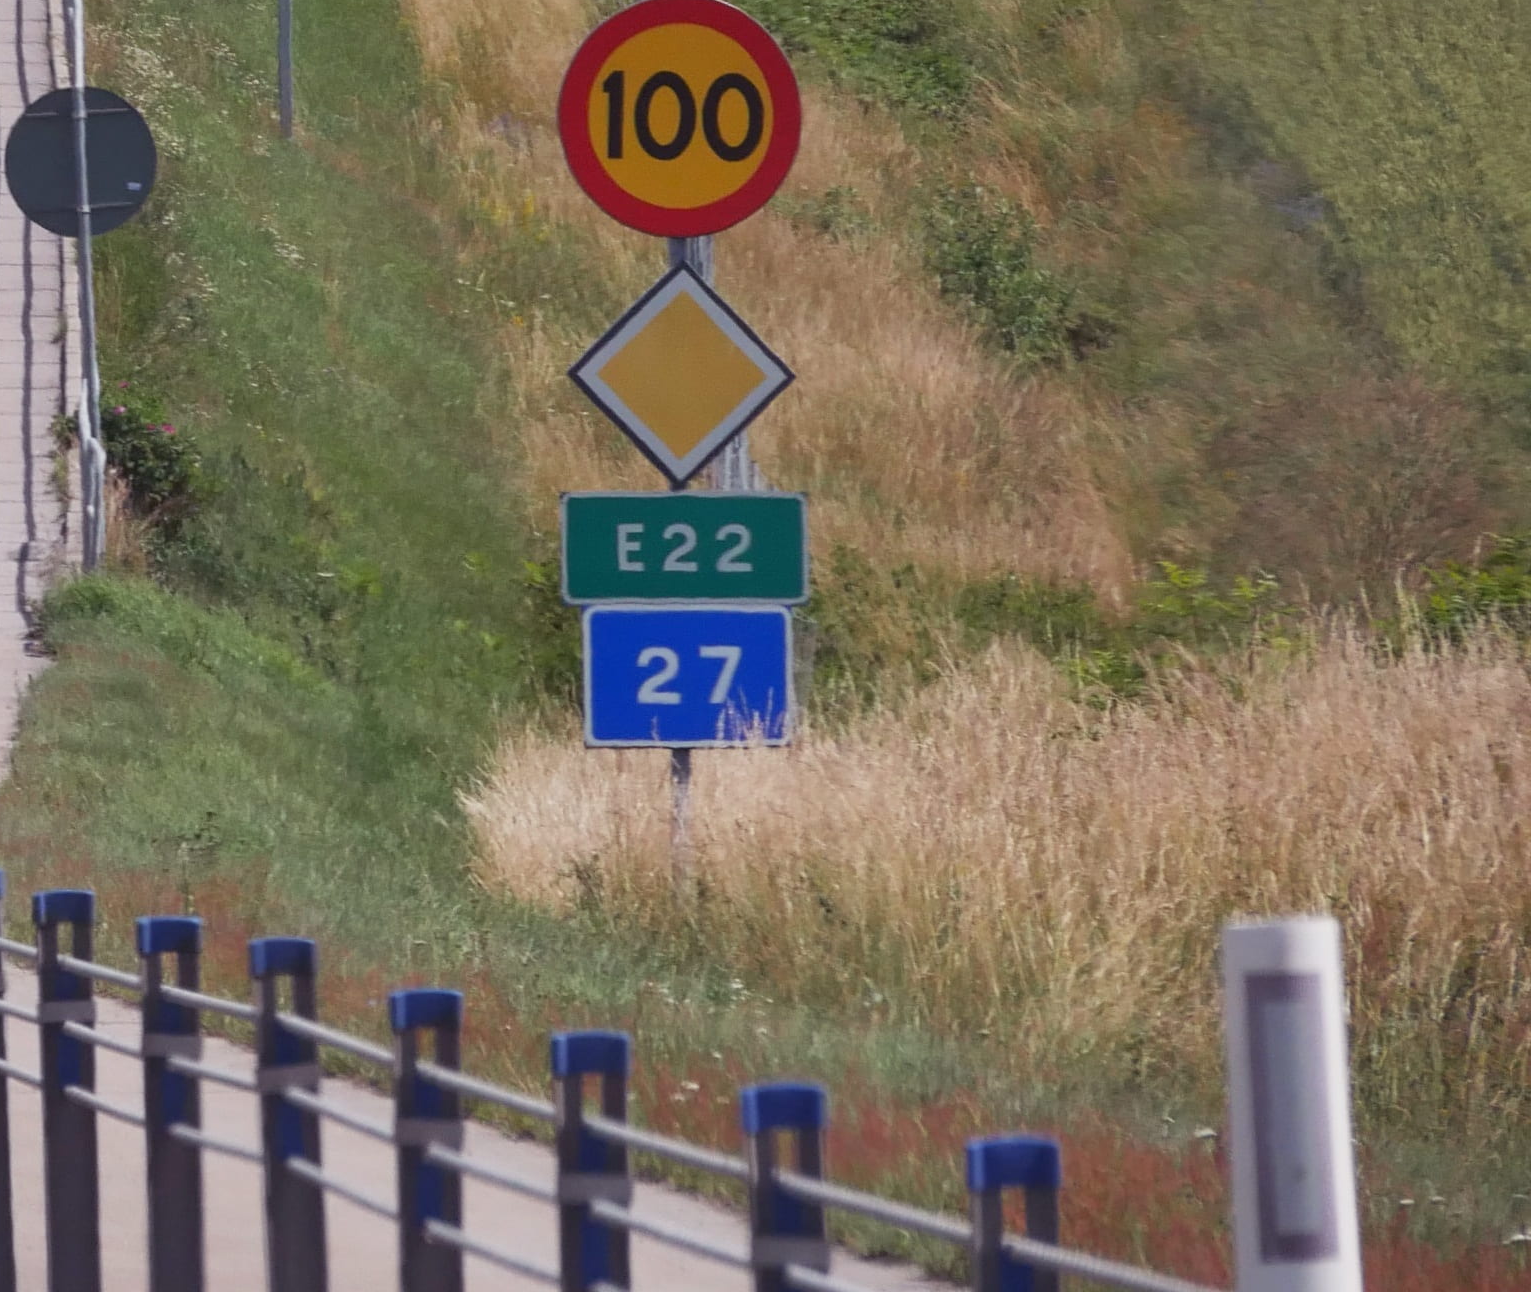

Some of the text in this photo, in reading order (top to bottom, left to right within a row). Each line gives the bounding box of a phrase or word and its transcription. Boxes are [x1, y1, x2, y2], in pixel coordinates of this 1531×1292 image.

[603, 70, 764, 163] 100
[616, 523, 753, 573] E22
[637, 645, 742, 705] 27
